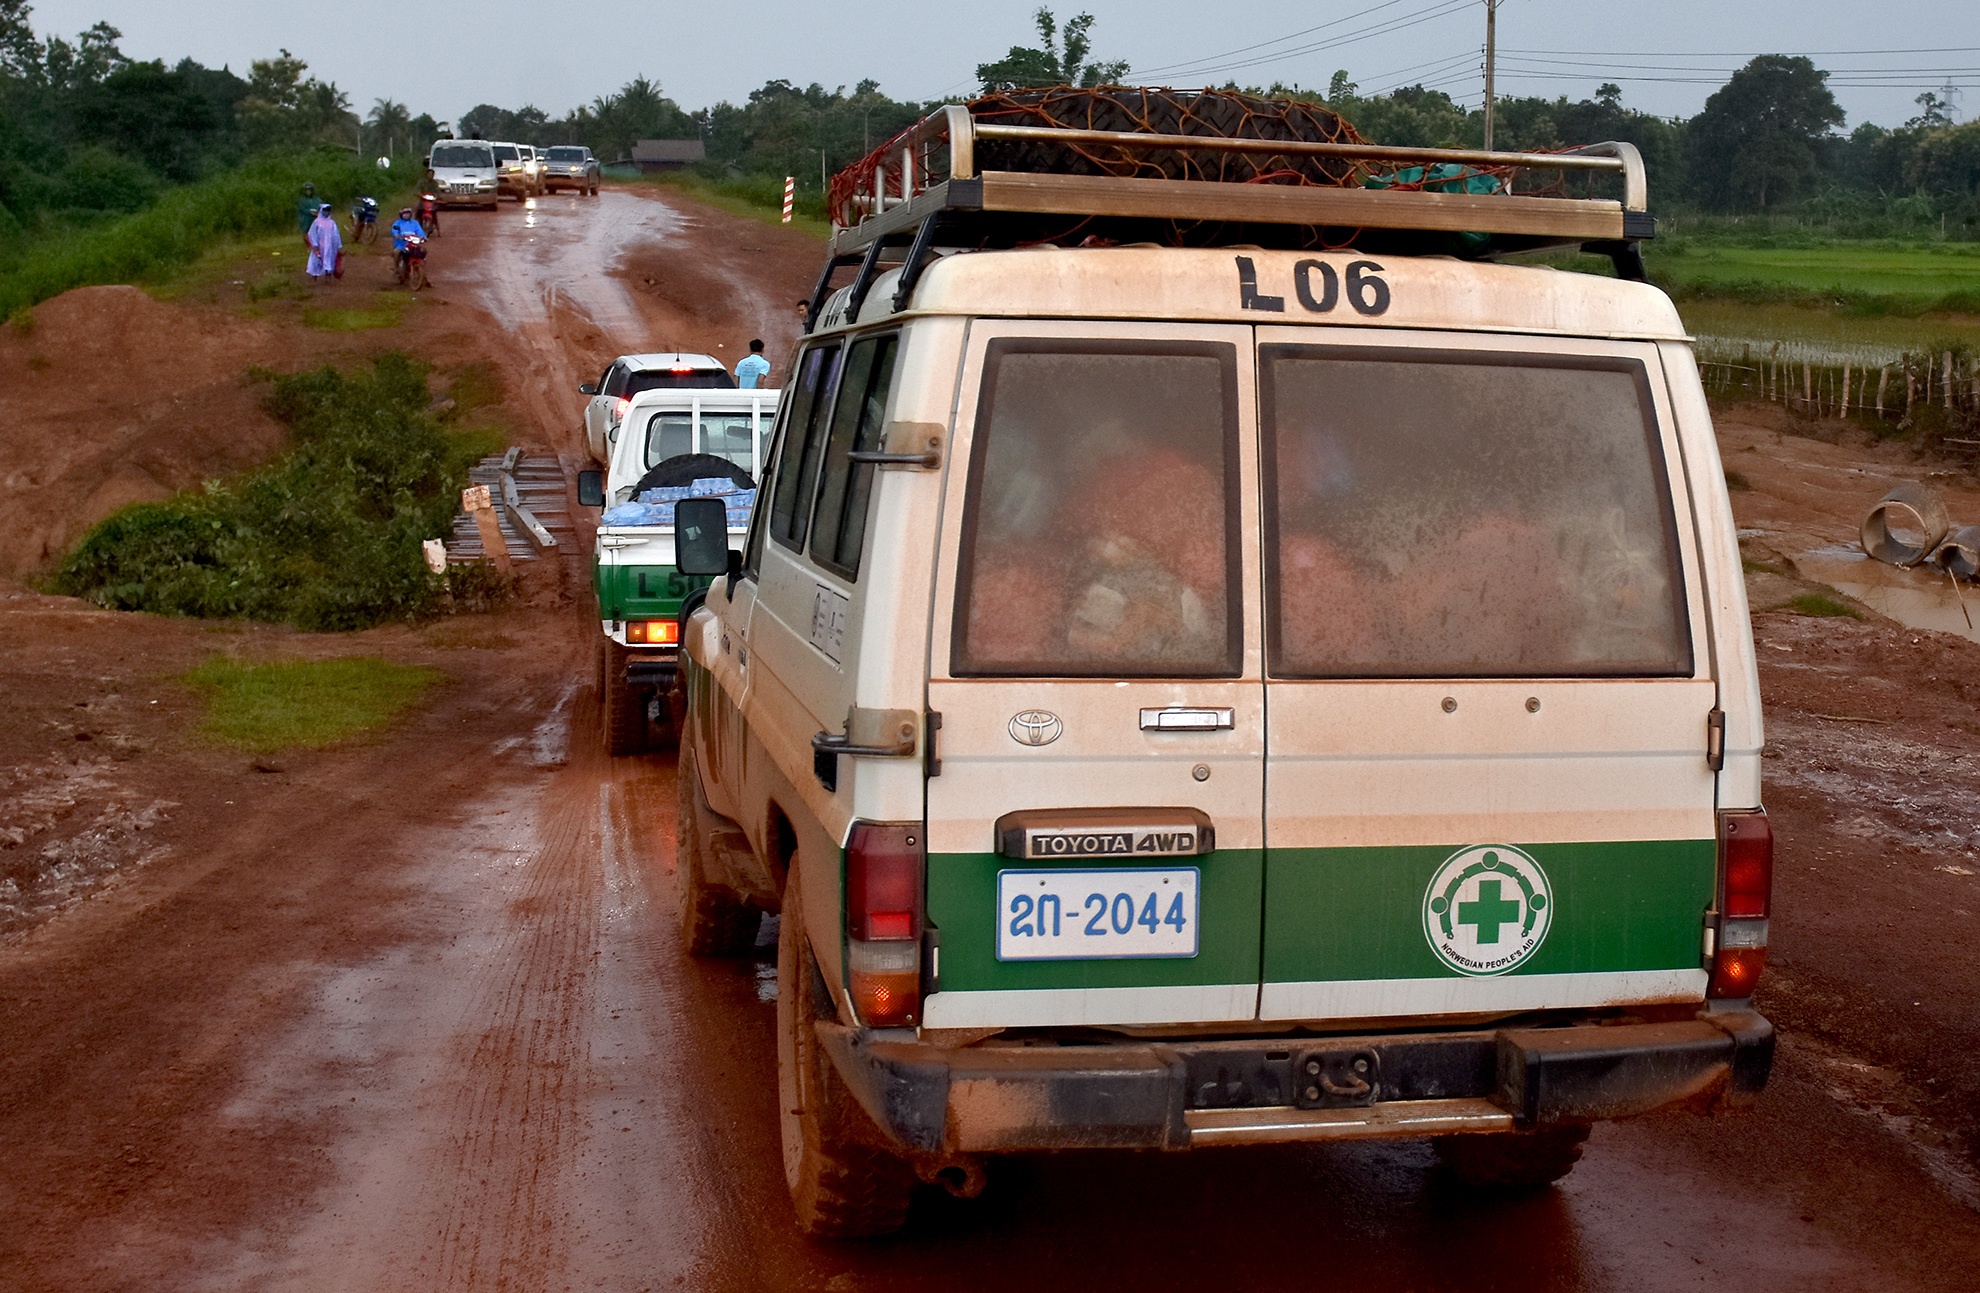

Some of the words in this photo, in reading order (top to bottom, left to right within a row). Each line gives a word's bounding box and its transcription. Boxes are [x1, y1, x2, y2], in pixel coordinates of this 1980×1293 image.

[1235, 255, 1284, 312] L
[1294, 259, 1391, 317] 06
[638, 573, 656, 598] L
[1037, 835, 1128, 853] TOYOTA
[1136, 833, 1195, 852] 4WD
[1441, 943, 1483, 969] NORWEGIAN
[1485, 951, 1522, 969] PEOPLE'S
[1523, 938, 1535, 952] AID
